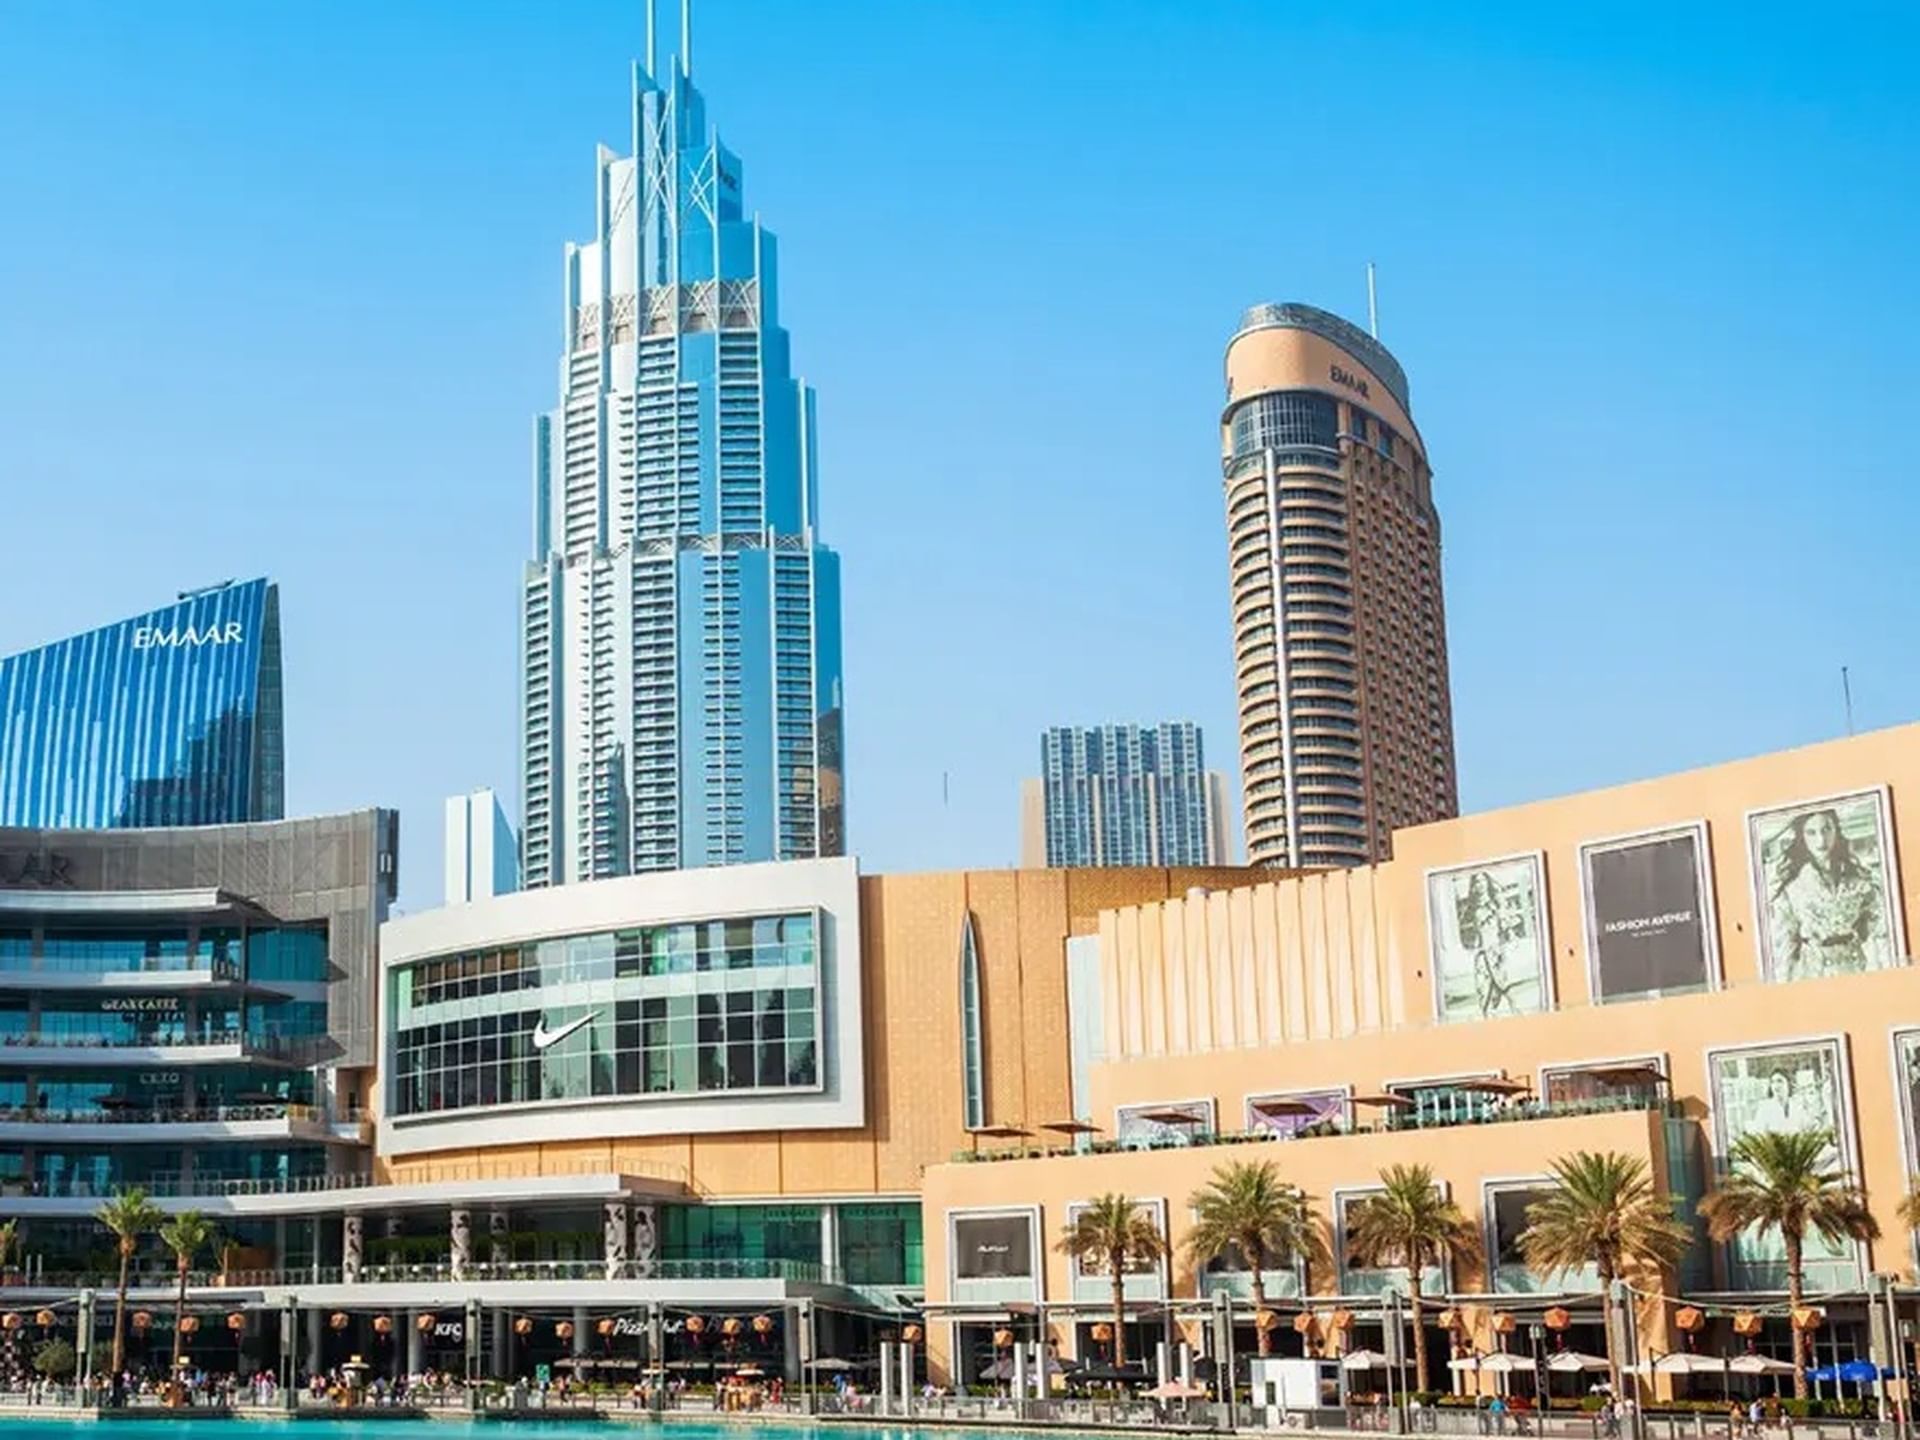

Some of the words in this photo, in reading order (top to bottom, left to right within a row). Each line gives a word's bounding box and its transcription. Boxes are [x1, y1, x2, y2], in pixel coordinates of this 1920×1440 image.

[134, 622, 243, 649] EMAAR
[1605, 918, 1650, 932] FASHION
[1651, 910, 1692, 926] AVENUE
[434, 1323, 463, 1338] KFC
